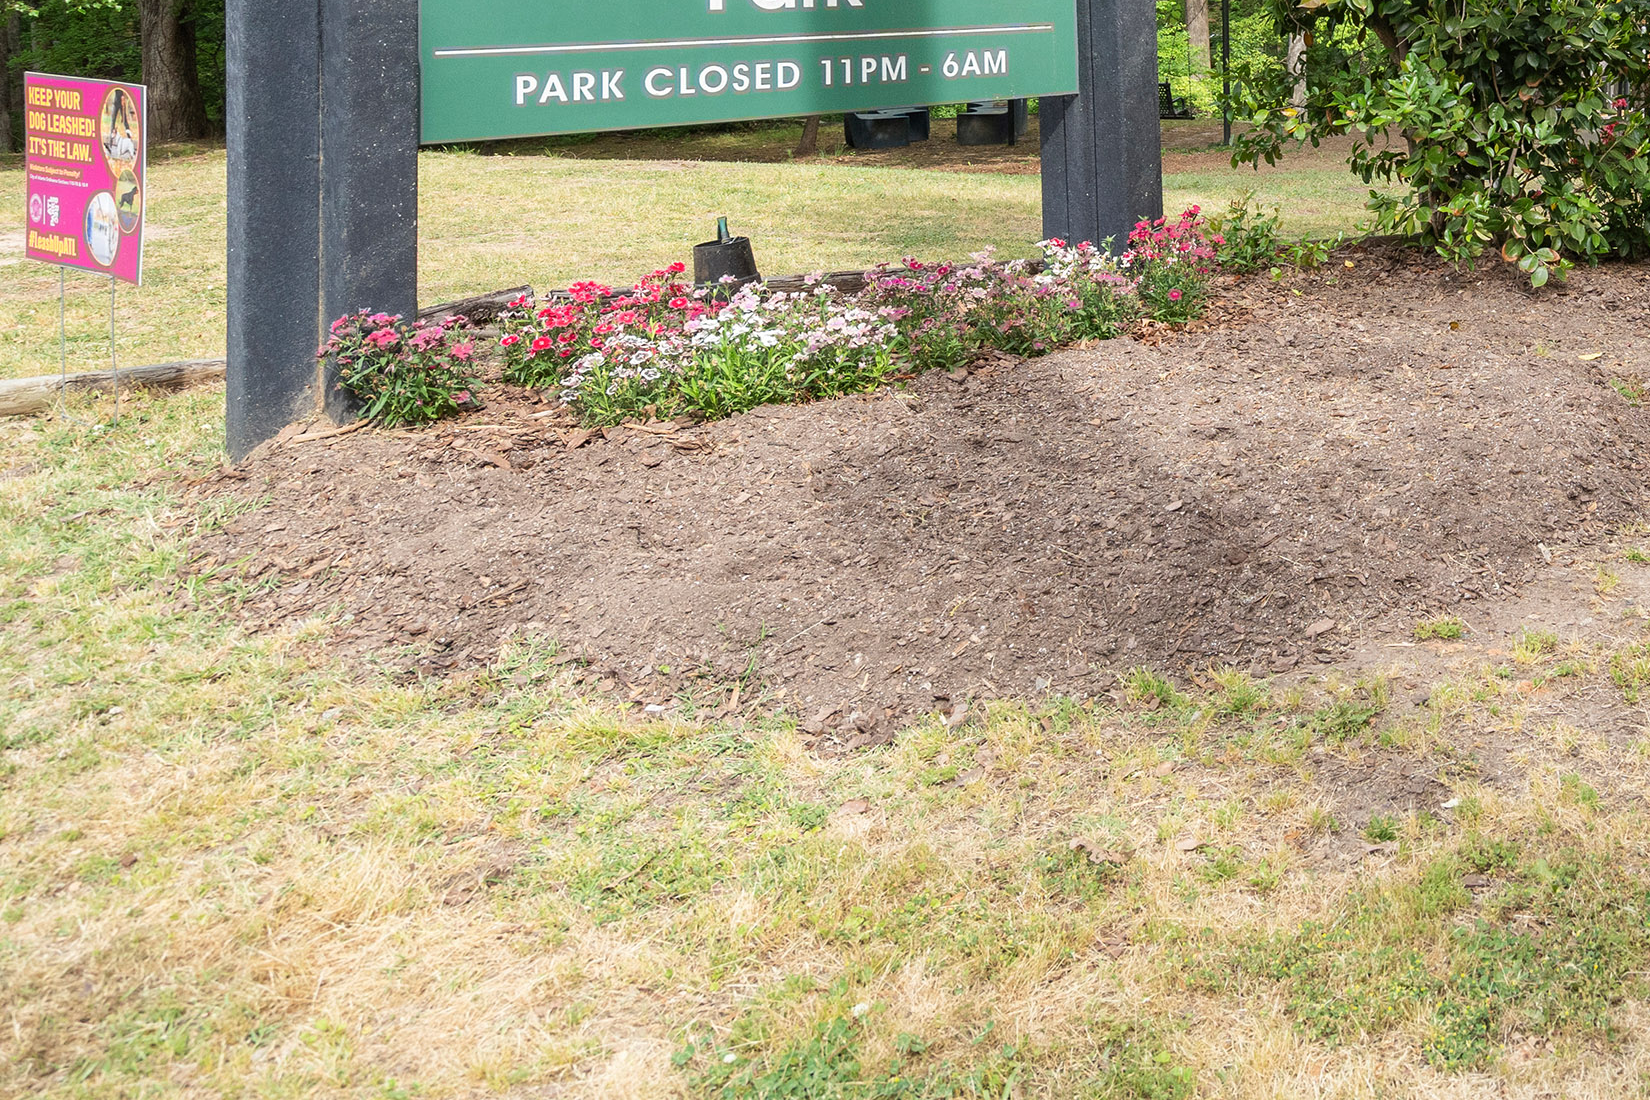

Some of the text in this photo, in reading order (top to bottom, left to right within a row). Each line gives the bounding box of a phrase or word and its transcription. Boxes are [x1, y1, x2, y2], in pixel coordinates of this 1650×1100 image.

[515, 70, 624, 105] PARK
[644, 61, 801, 96] CLOSED
[820, 54, 907, 86] 11PM
[943, 50, 1007, 78] 6AM
[28, 86, 81, 110] KEEP YOUR
[29, 111, 96, 137] DOG LEASHED!
[29, 136, 92, 162] IT'S THE LAW.
[29, 230, 77, 257] #LeashUpATL
